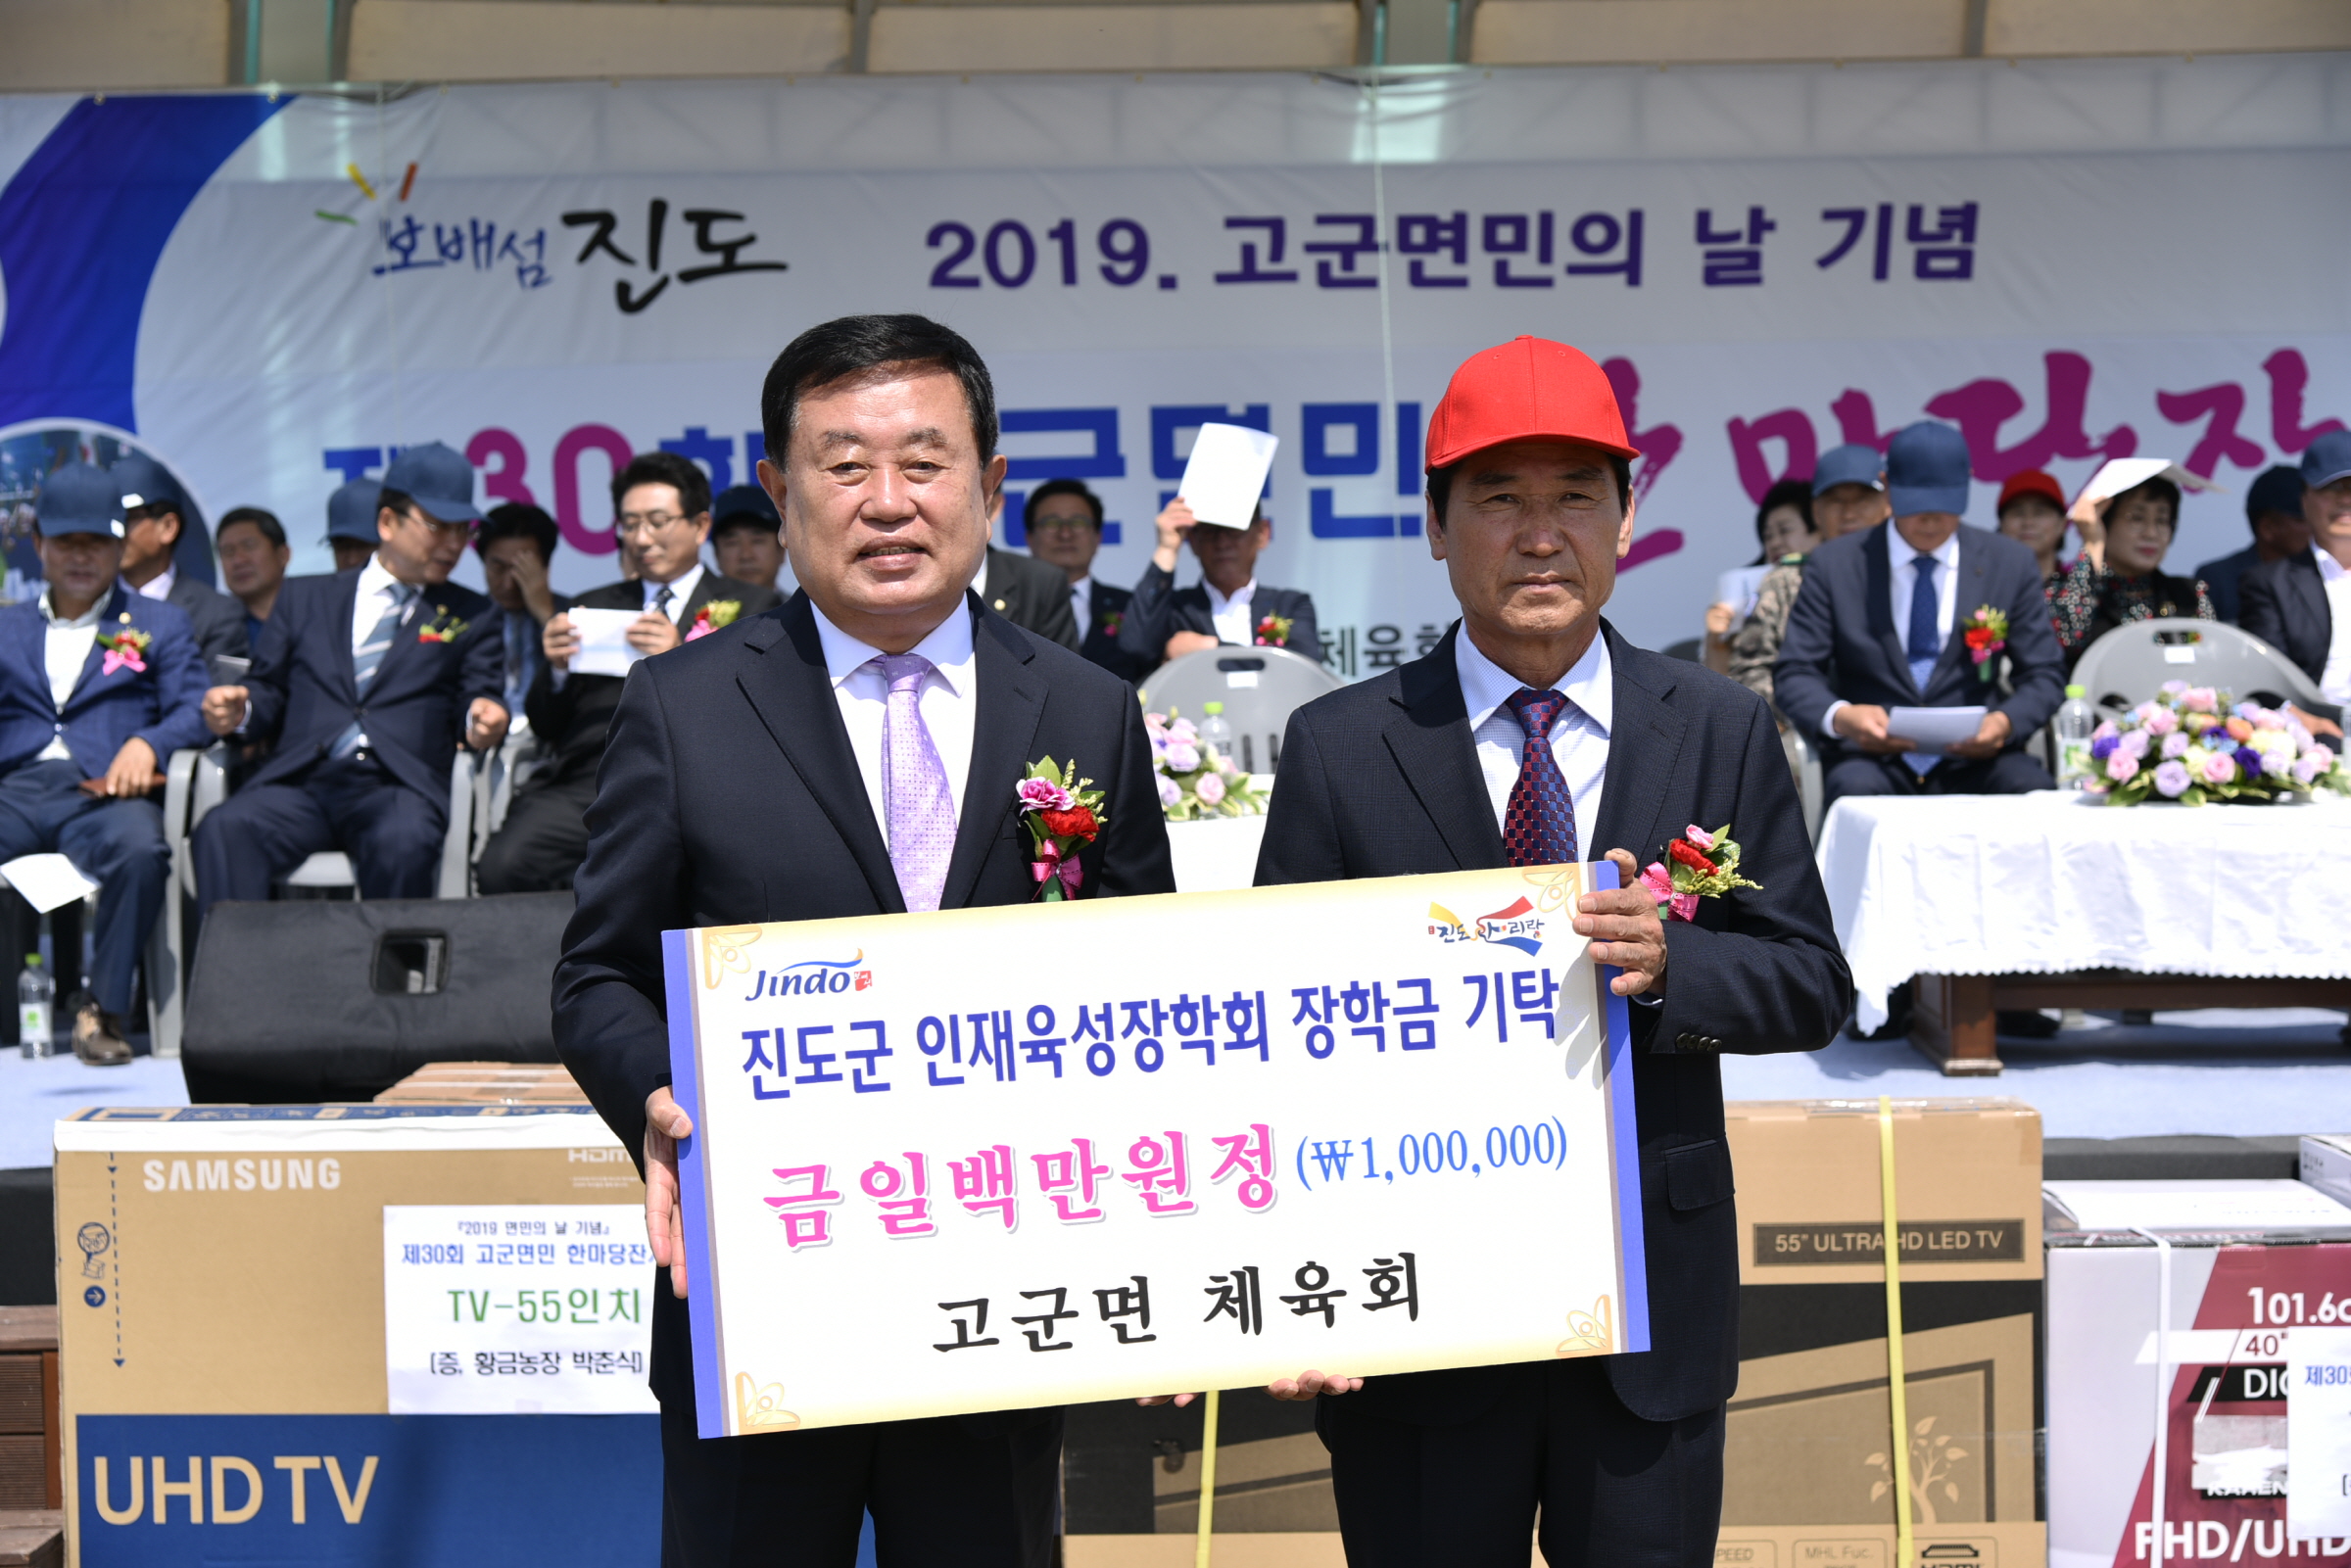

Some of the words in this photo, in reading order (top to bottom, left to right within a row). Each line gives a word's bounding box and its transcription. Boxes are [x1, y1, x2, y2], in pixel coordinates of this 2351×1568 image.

[372, 214, 552, 291] 보배섬
[560, 198, 789, 315] 진도
[926, 217, 1178, 290] 2019.
[1214, 209, 1644, 290] 고군면민의
[1695, 206, 1776, 286] 날
[1816, 202, 1979, 281] 기념
[744, 968, 850, 1002] Jindo
[742, 1020, 893, 1101] 진도군
[916, 989, 1270, 1087] 인재육성장학회
[1291, 977, 1440, 1060] 장학금
[1463, 968, 1559, 1043] 기탁
[568, 1148, 637, 1164] HDM
[142, 1158, 342, 1193] SAMSUNG
[505, 1221, 547, 1235] 면민의
[554, 1221, 568, 1236] 날
[1927, 1231, 1971, 1251] LED
[1975, 1229, 2003, 1250] TV
[402, 1243, 464, 1265] 제30회
[476, 1243, 555, 1265] 고군면민
[447, 1288, 642, 1324] TV-55인치
[933, 1275, 1158, 1354] 고군면
[1203, 1252, 1419, 1335] 체육회
[474, 1352, 560, 1375] 황금농장
[95, 1455, 264, 1525] UHD
[273, 1455, 379, 1524] TV
[1715, 1547, 1753, 1561] PEED
